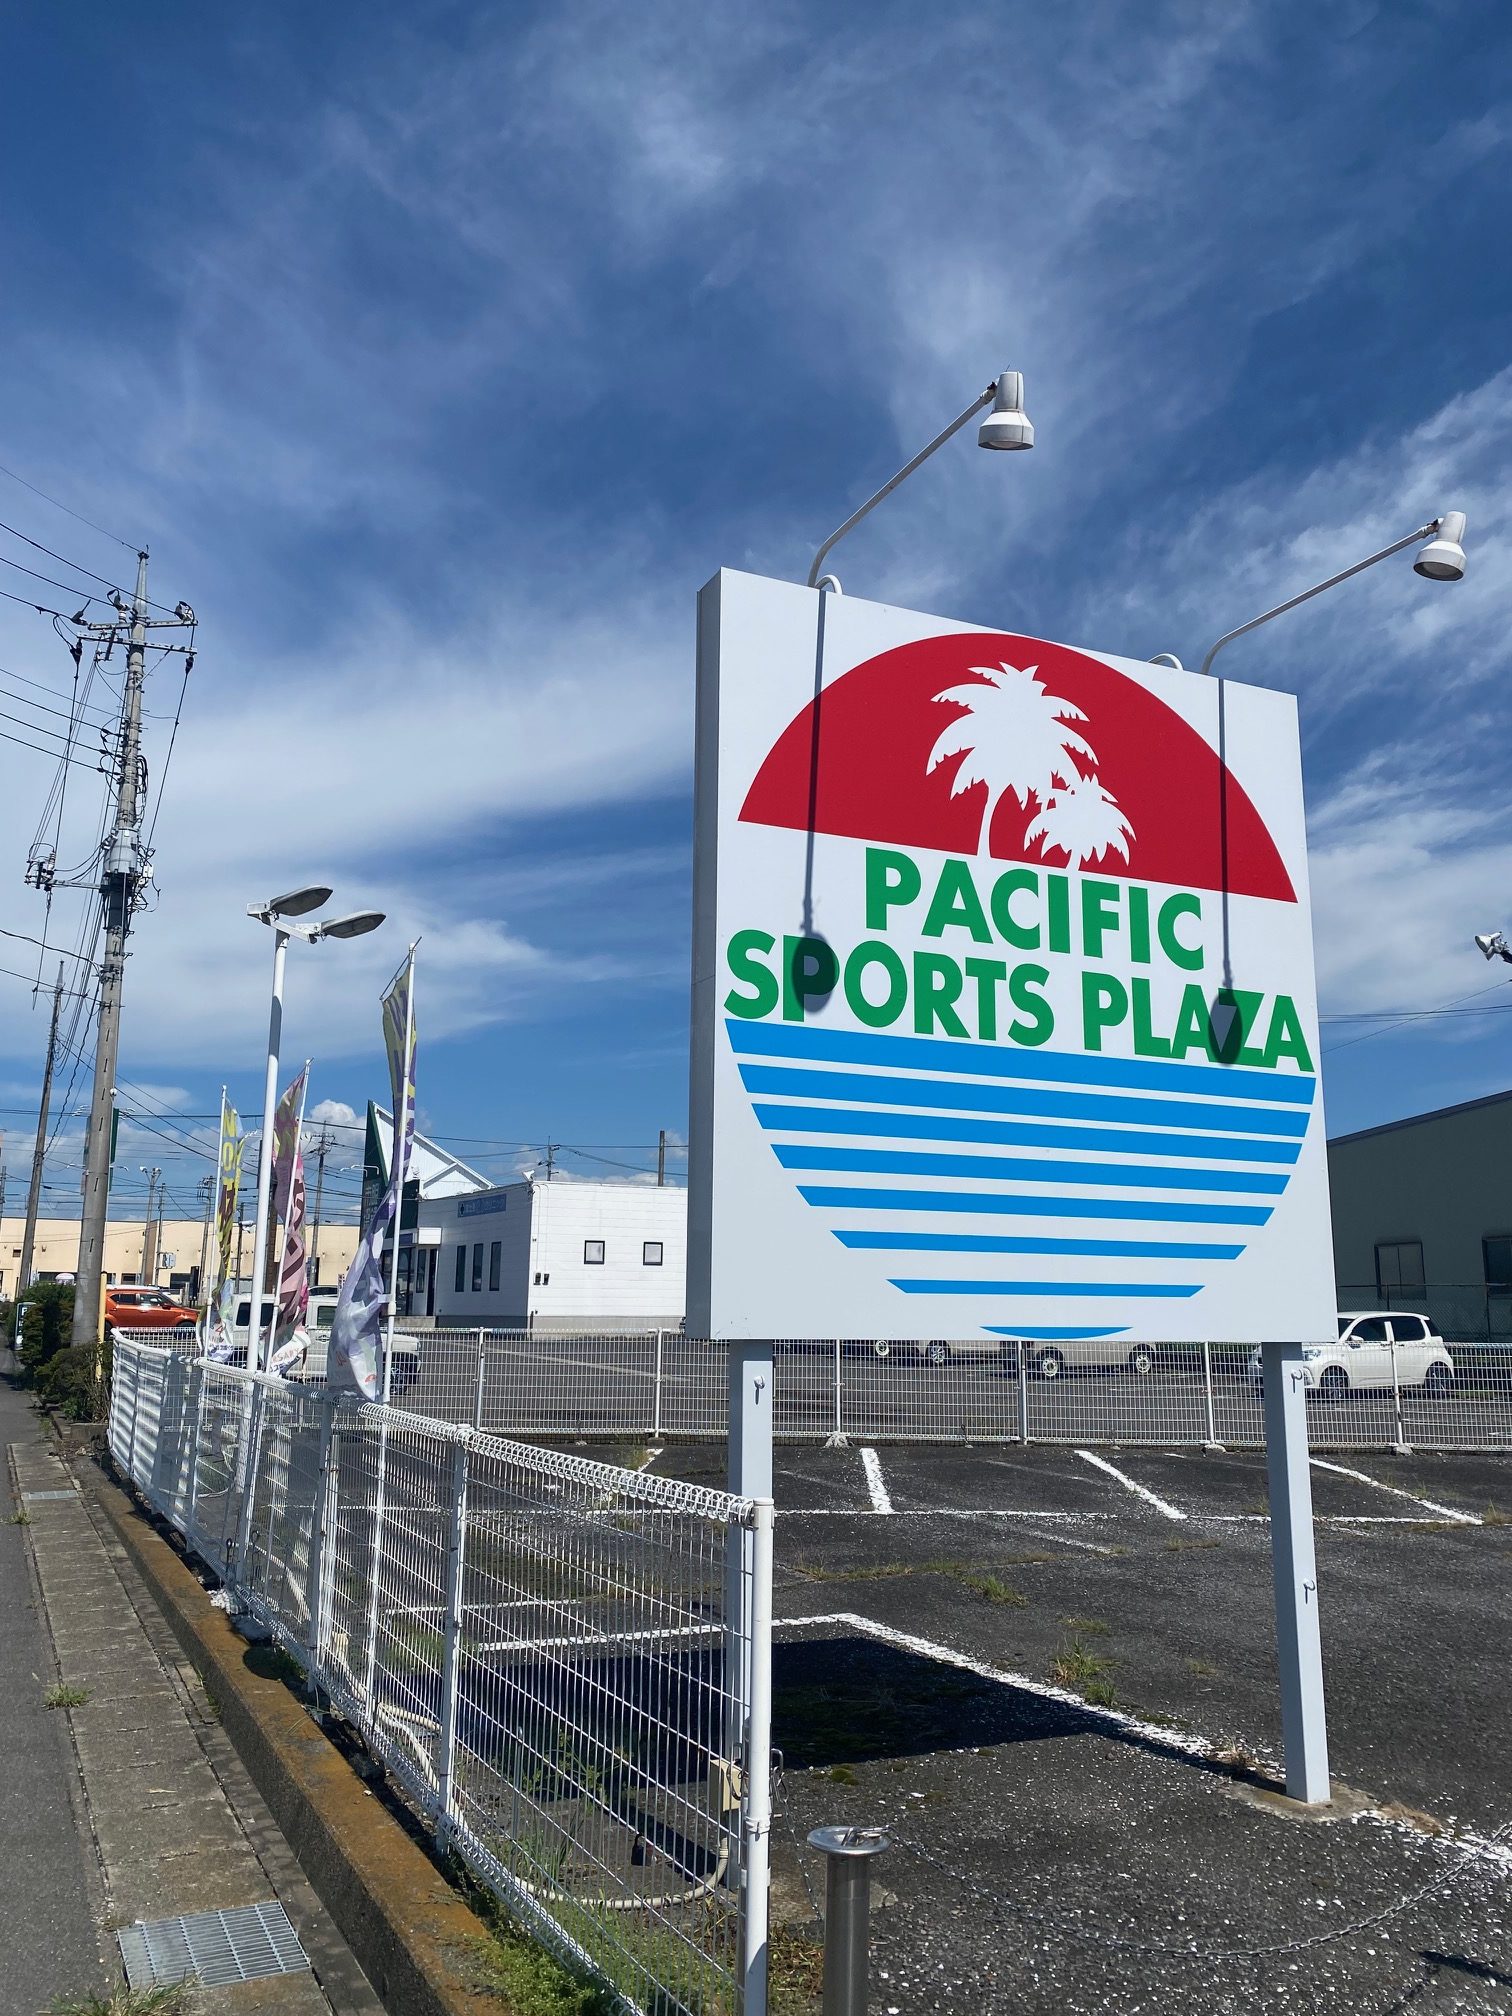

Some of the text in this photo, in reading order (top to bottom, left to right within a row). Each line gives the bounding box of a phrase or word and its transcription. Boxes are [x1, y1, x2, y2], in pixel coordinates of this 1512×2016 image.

[865, 847, 1204, 971] PACIFIC
[723, 929, 1315, 1073] SPORTS PLAZA
